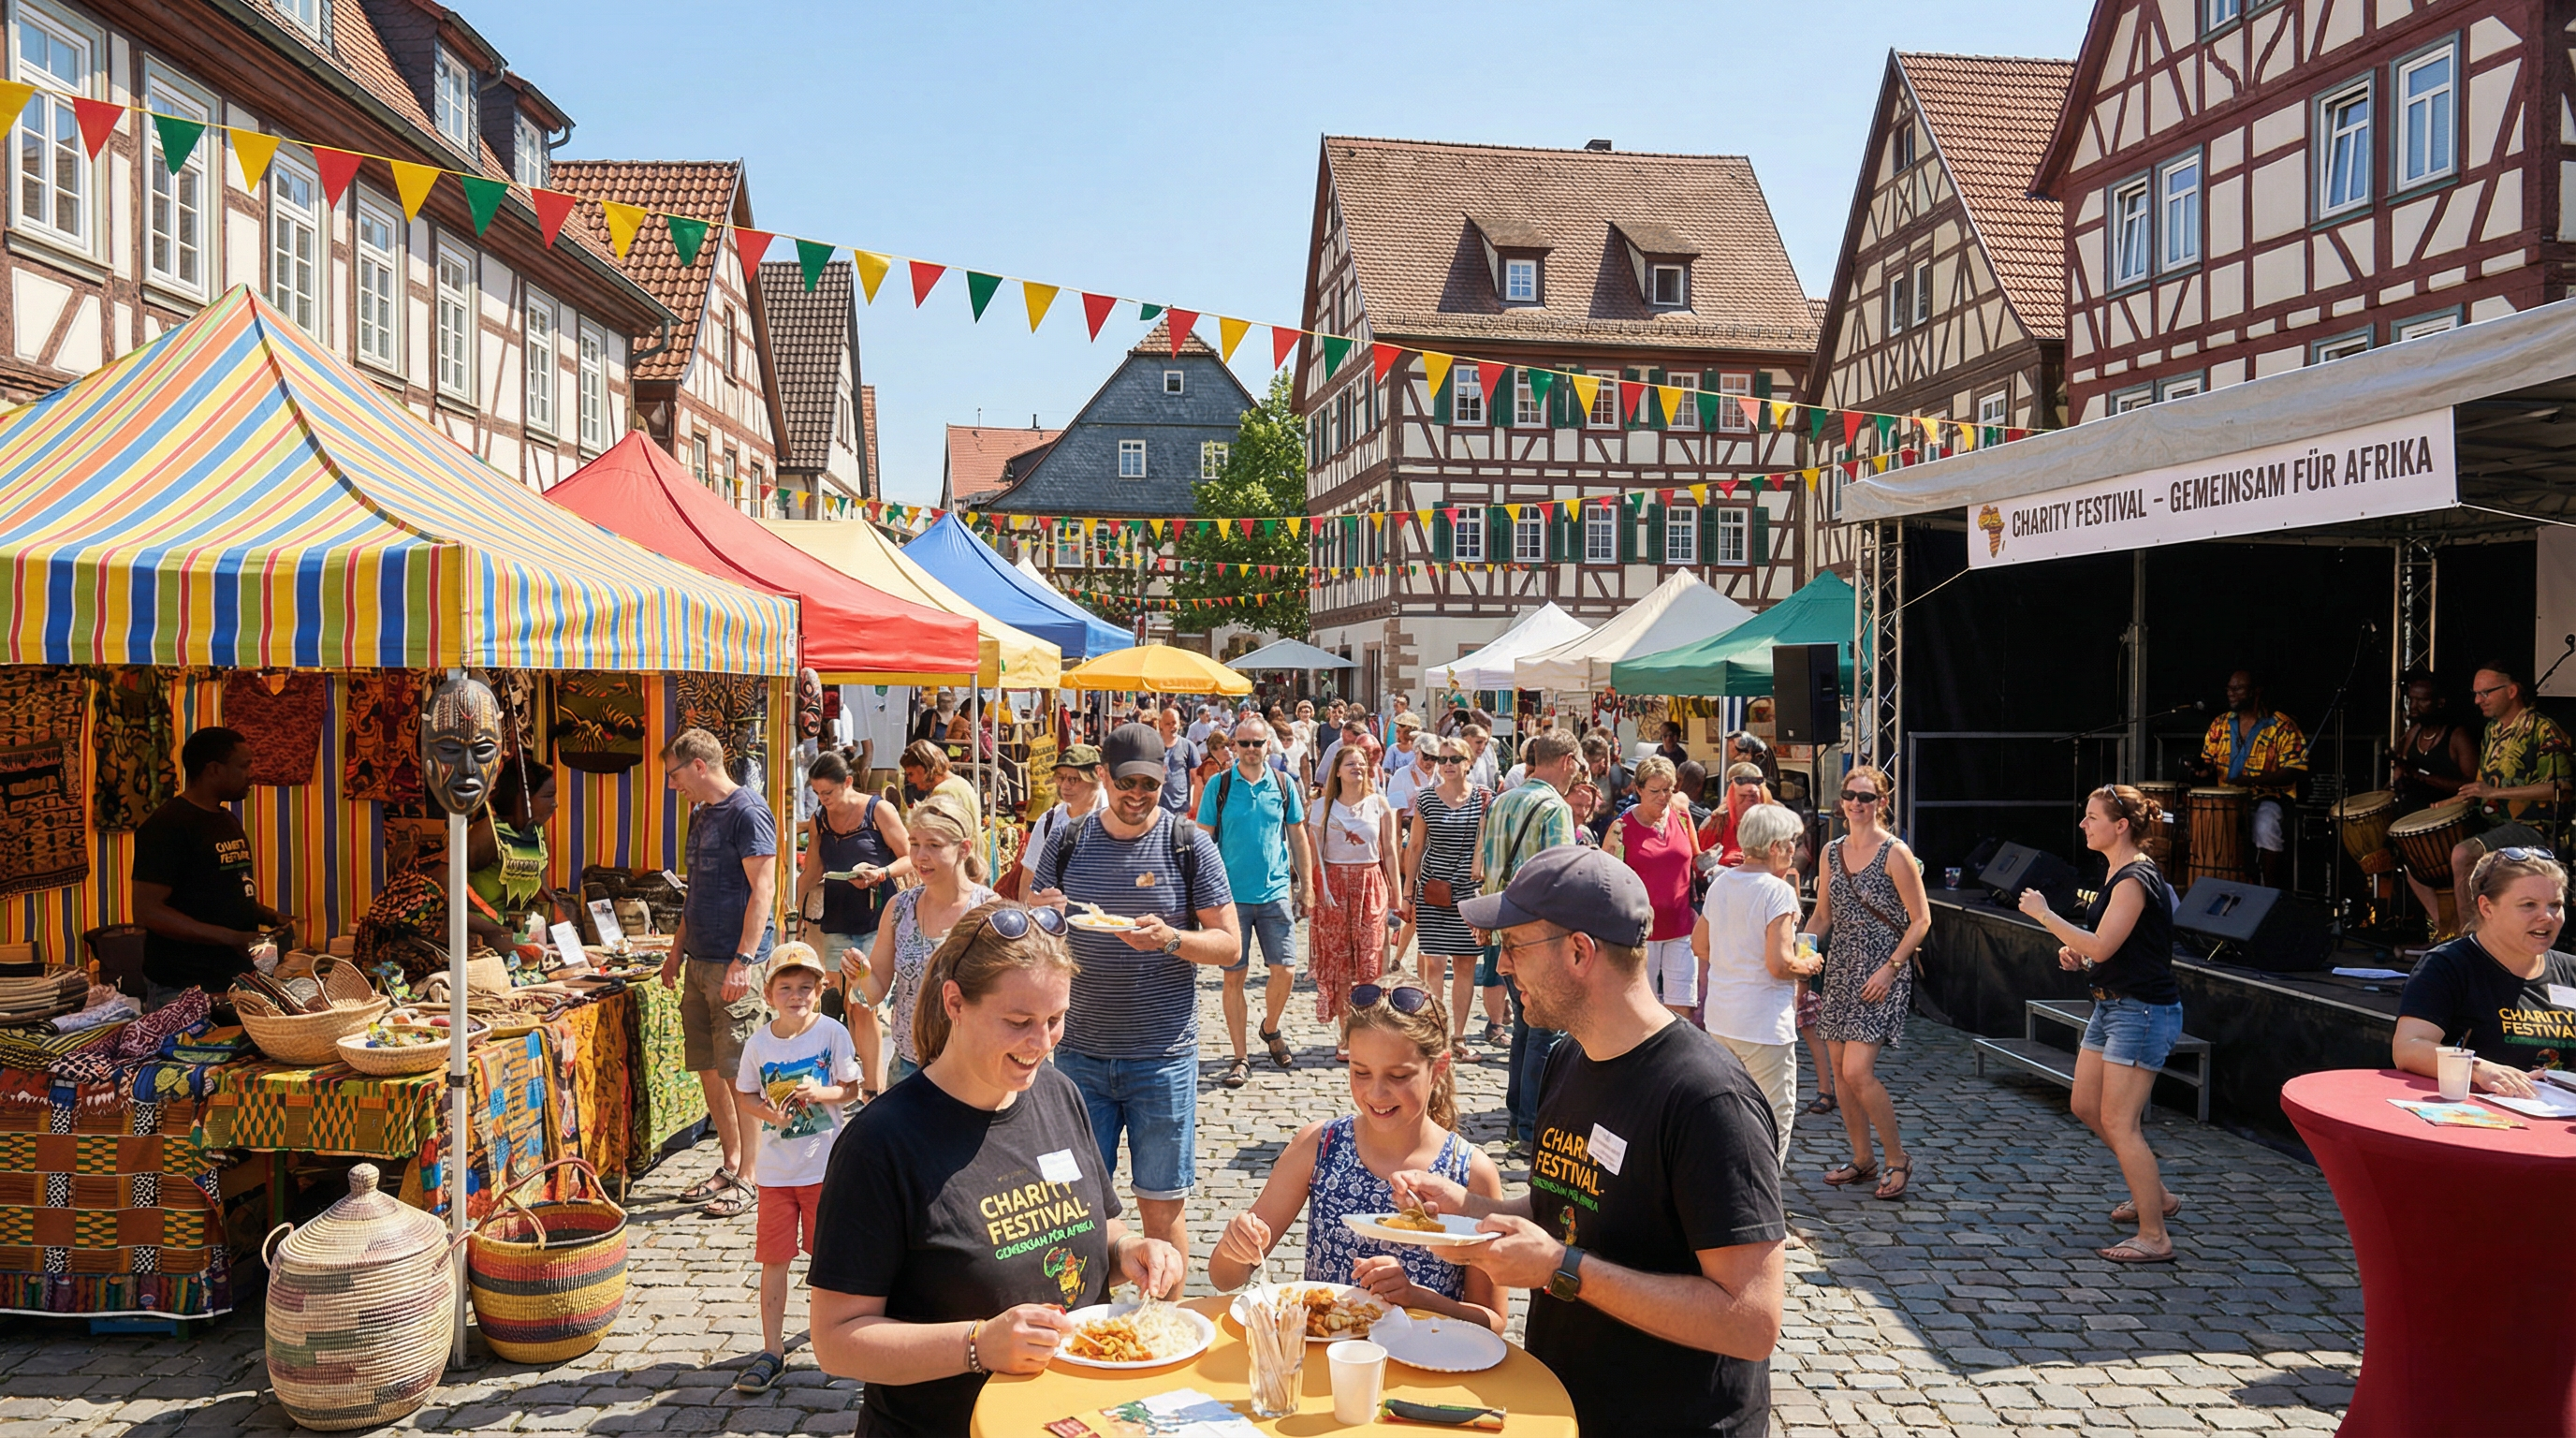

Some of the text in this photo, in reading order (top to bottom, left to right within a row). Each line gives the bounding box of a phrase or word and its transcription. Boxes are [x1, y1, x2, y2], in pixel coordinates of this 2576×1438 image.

[2012, 501, 2071, 537] CHARITY
[2075, 488, 2146, 527] FESTIVAL
[2170, 462, 2285, 512] GEMEINSAM
[2292, 448, 2335, 493] FÜR
[2343, 435, 2433, 485] AFRIKA
[2497, 1007, 2575, 1024] CHARITY
[2501, 1020, 2576, 1038] FESTIVA
[1535, 1150, 1599, 1196] FESTIVAL
[987, 1196, 1089, 1245] FESTIVAL
